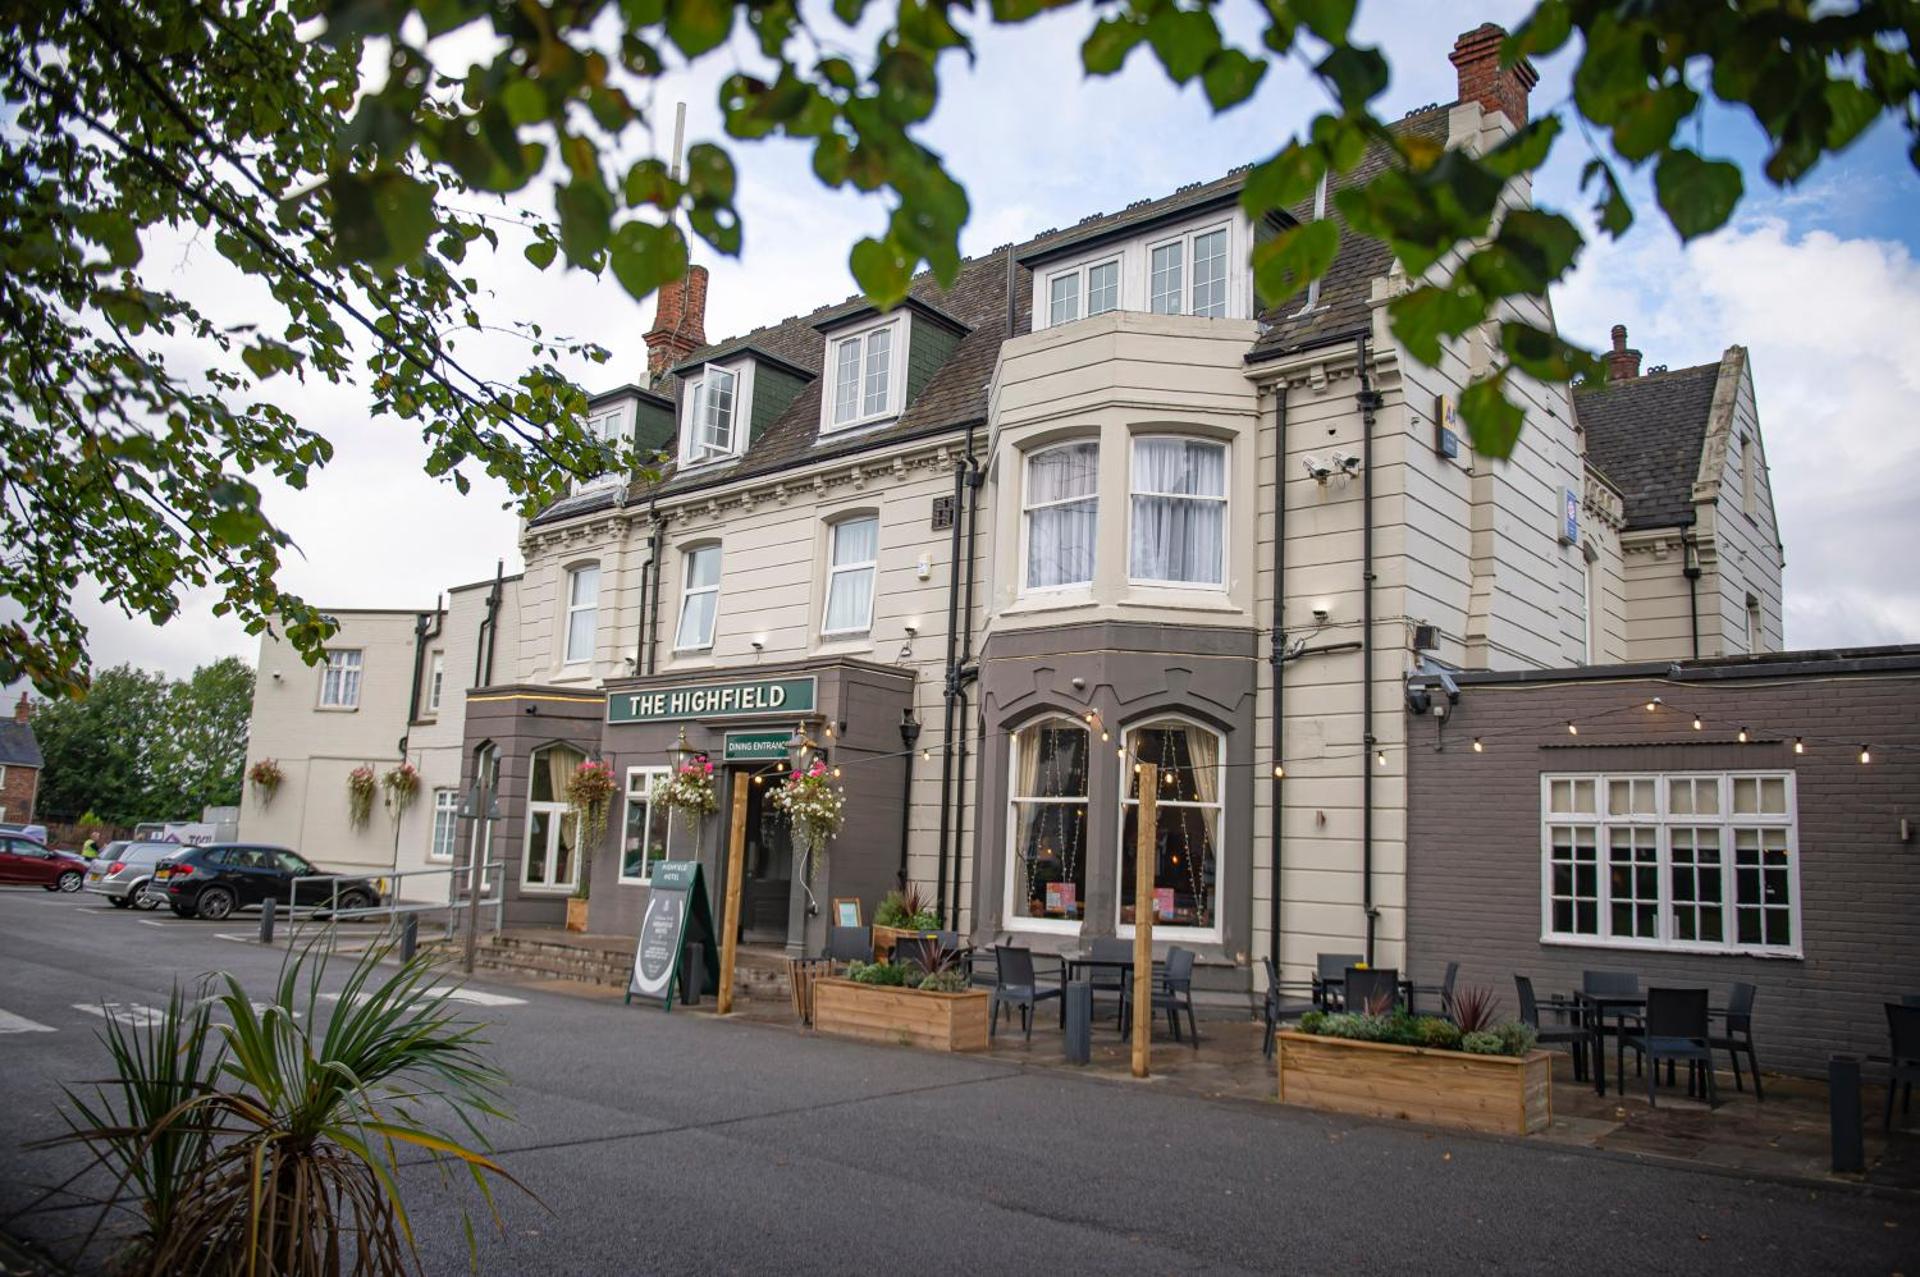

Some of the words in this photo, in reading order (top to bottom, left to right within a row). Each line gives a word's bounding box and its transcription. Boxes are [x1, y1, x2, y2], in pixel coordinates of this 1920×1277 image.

[630, 694, 665, 716] THE
[670, 685, 785, 714] HIGHFIELD
[729, 741, 752, 751] DINING
[753, 740, 788, 751] ENTRANC
